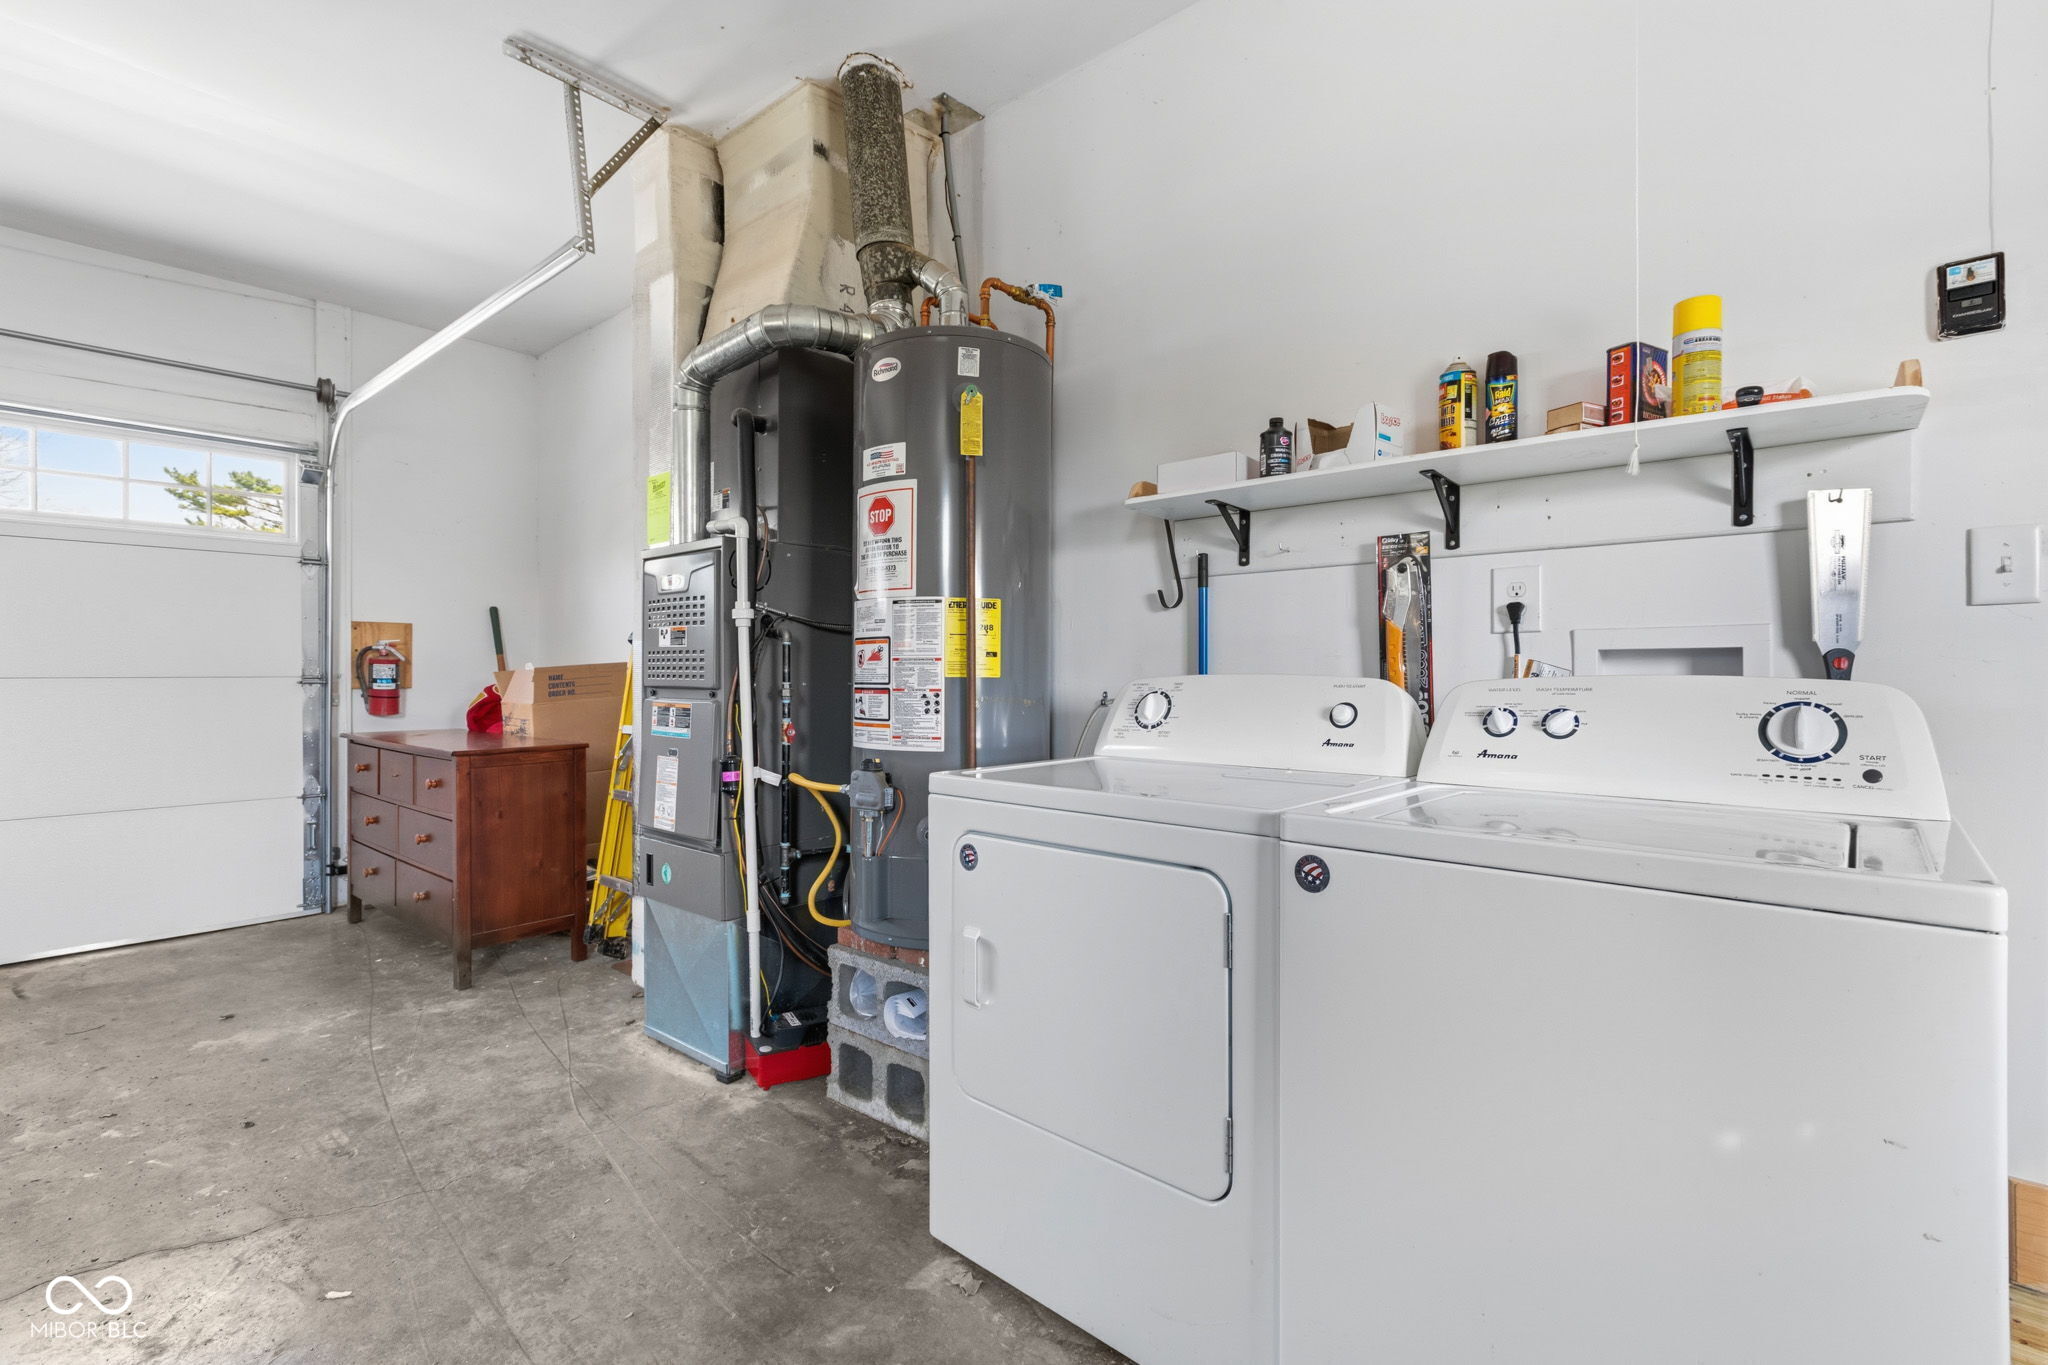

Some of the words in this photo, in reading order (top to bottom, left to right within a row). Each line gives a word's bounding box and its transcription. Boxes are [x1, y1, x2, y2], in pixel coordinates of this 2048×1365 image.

[869, 508, 892, 524] STOP
[883, 550, 908, 558] PURCHASE
[548, 681, 576, 689] CONTENTS
[1321, 738, 1355, 748] Amana
[1476, 748, 1519, 760] Amana
